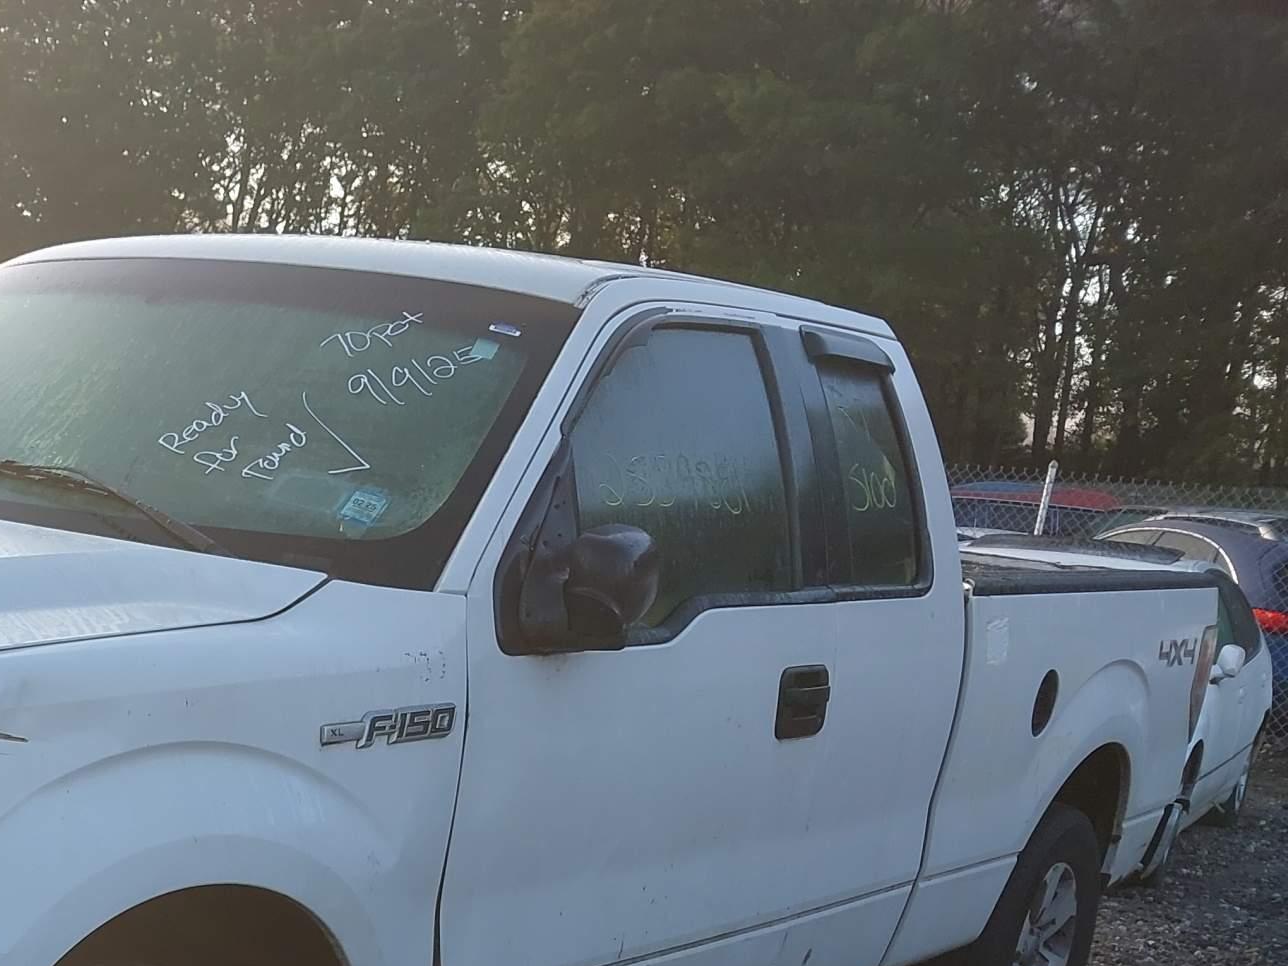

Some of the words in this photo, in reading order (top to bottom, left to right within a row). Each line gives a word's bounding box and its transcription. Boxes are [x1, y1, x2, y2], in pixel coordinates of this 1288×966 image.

[347, 345, 483, 406] 9/9/25
[158, 391, 269, 454] Ready
[330, 727, 345, 737] XL
